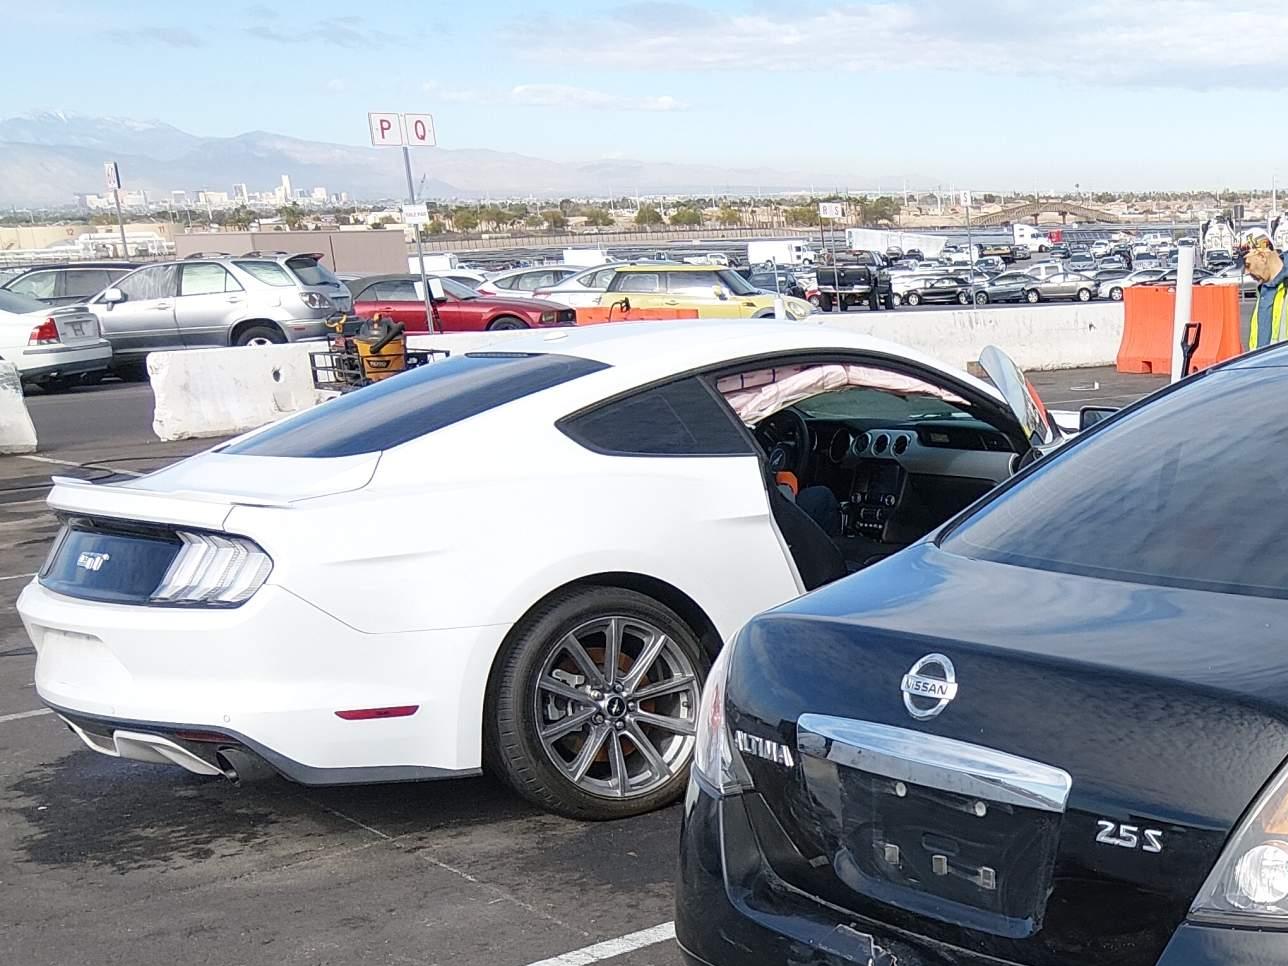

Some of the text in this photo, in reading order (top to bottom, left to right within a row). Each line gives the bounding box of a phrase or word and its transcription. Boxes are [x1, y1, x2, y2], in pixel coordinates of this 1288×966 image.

[380, 119, 391, 139] P
[415, 120, 426, 140] Q
[905, 675, 948, 695] NISSAN
[735, 730, 794, 767] ALTIMA
[1142, 829, 1162, 853] S
